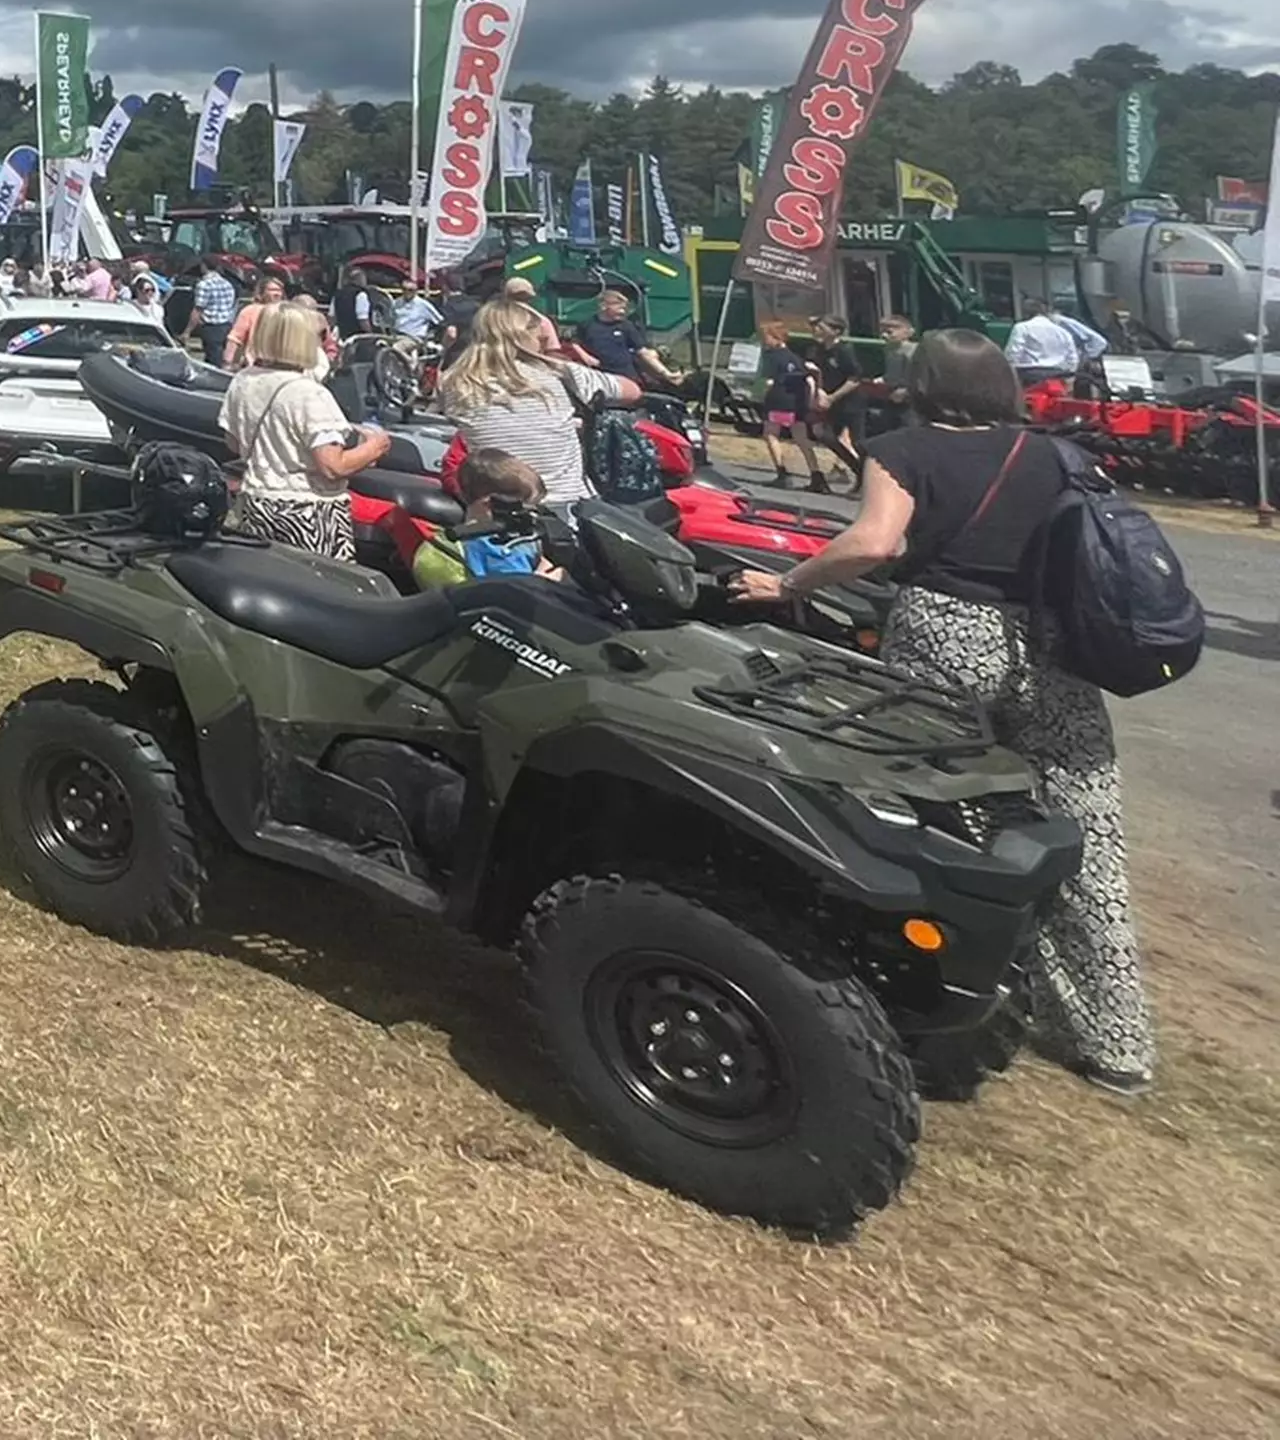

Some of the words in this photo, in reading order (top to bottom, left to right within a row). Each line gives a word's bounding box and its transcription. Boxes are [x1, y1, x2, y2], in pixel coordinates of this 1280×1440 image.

[203, 101, 226, 141] LYNX
[436, 1, 510, 237] CROSS
[1126, 91, 1141, 183] SPEARHEAD
